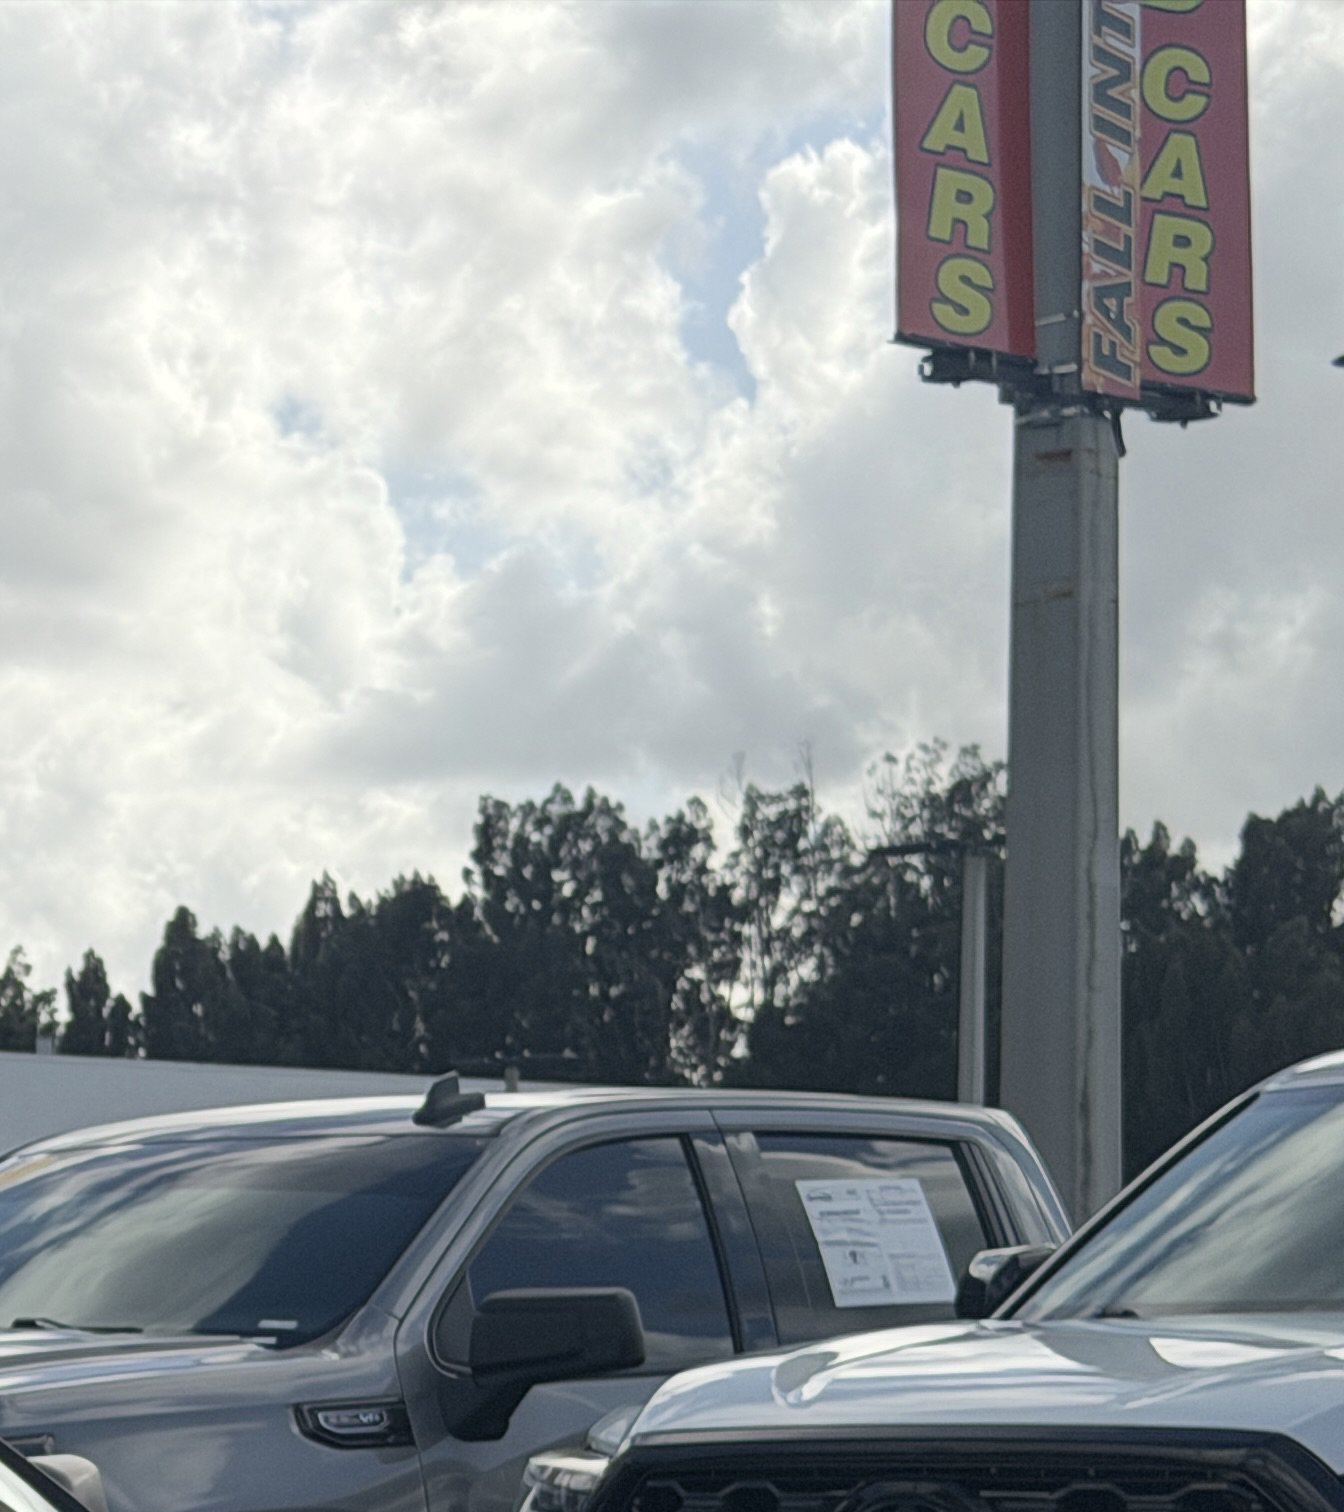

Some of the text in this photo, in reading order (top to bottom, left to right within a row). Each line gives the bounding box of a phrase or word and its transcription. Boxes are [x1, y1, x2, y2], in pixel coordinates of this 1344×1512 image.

[920, 0, 996, 337] CARS
[1087, 0, 1138, 388] FALL INT
[1140, 44, 1215, 376] CARS
